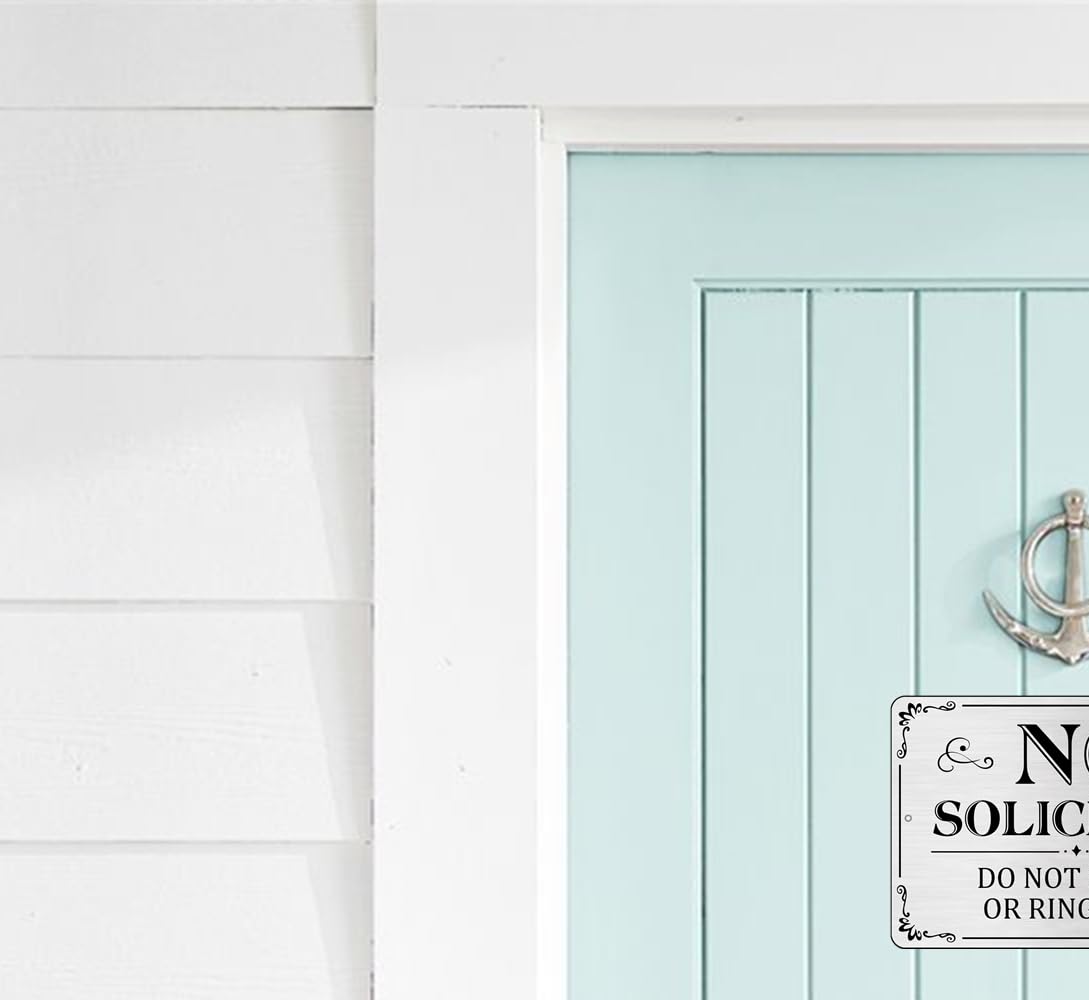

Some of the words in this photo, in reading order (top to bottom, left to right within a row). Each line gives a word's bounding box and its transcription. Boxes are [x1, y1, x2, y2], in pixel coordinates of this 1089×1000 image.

[977, 867, 1016, 889] DO
[1024, 867, 1081, 889] NOT
[983, 897, 1021, 920] OR
